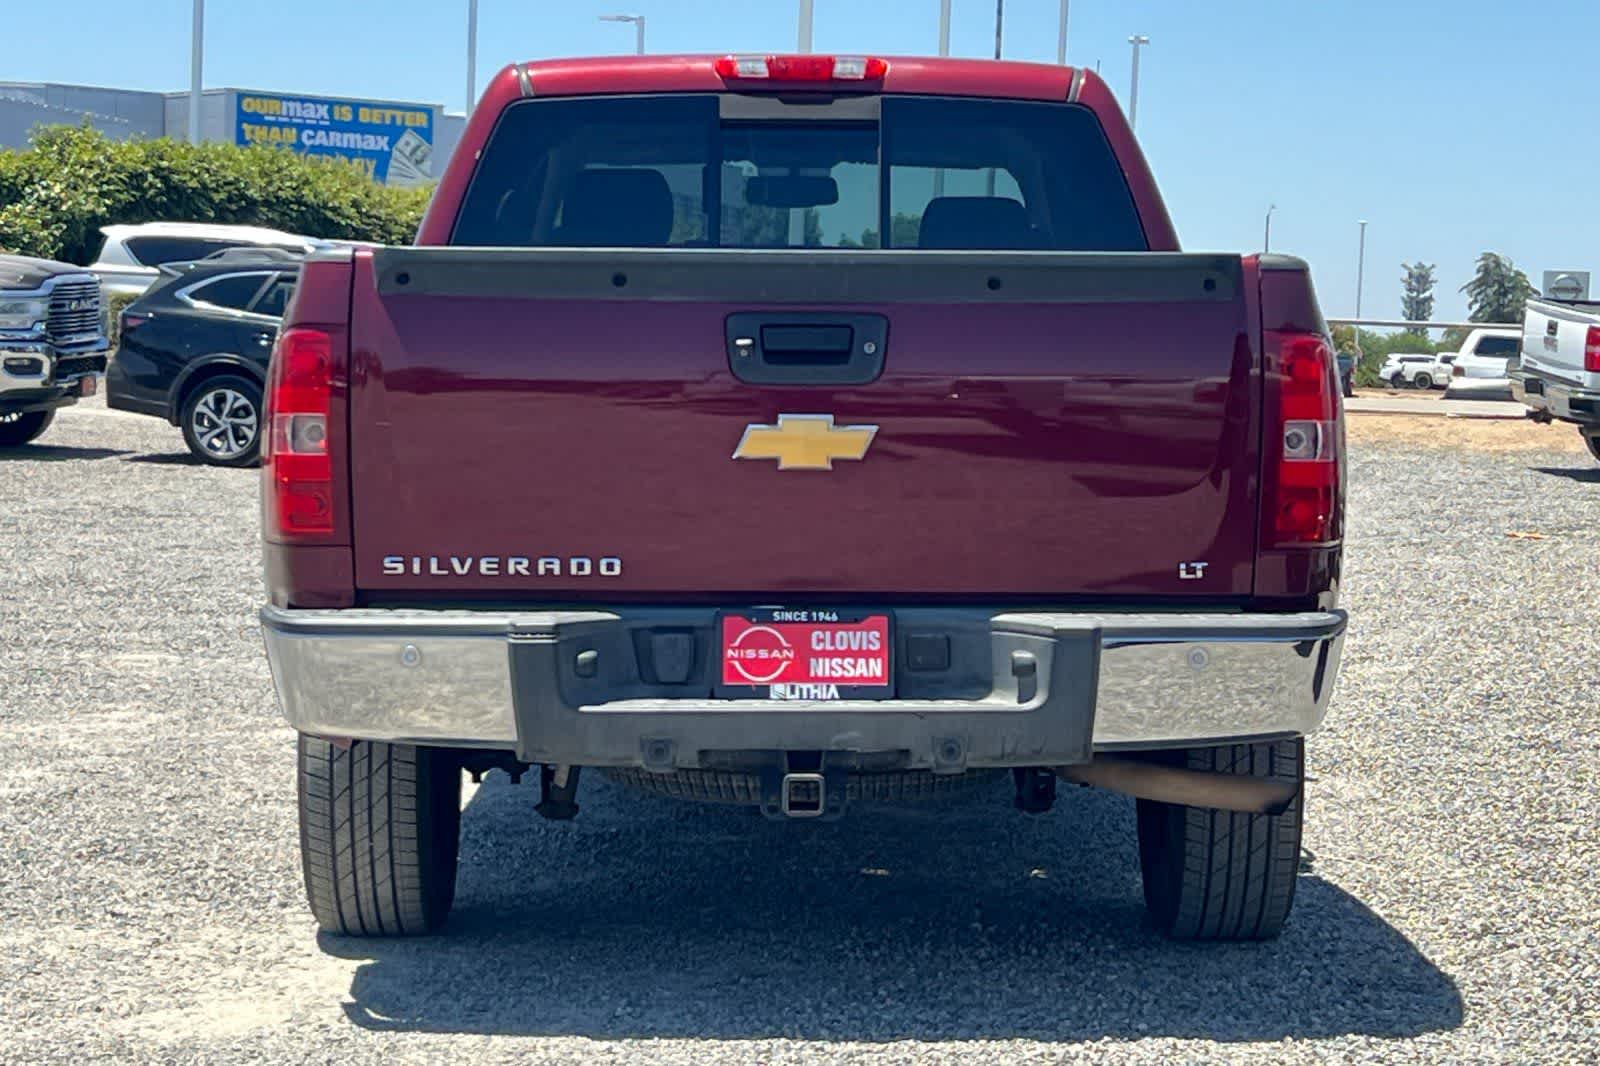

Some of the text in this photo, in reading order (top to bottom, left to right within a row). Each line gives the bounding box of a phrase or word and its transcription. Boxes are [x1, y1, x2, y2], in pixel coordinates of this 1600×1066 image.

[333, 105, 353, 122] IS
[358, 108, 428, 128] BETTER
[242, 122, 298, 145] THAN
[382, 556, 623, 577] SILVERADO
[1179, 562, 1209, 579] LT
[772, 611, 839, 622] SINCE 1946
[810, 630, 881, 651] CLOVIS
[727, 649, 794, 659] NISSAN
[809, 657, 883, 678] NISSAN
[786, 684, 840, 699] LITHIA
